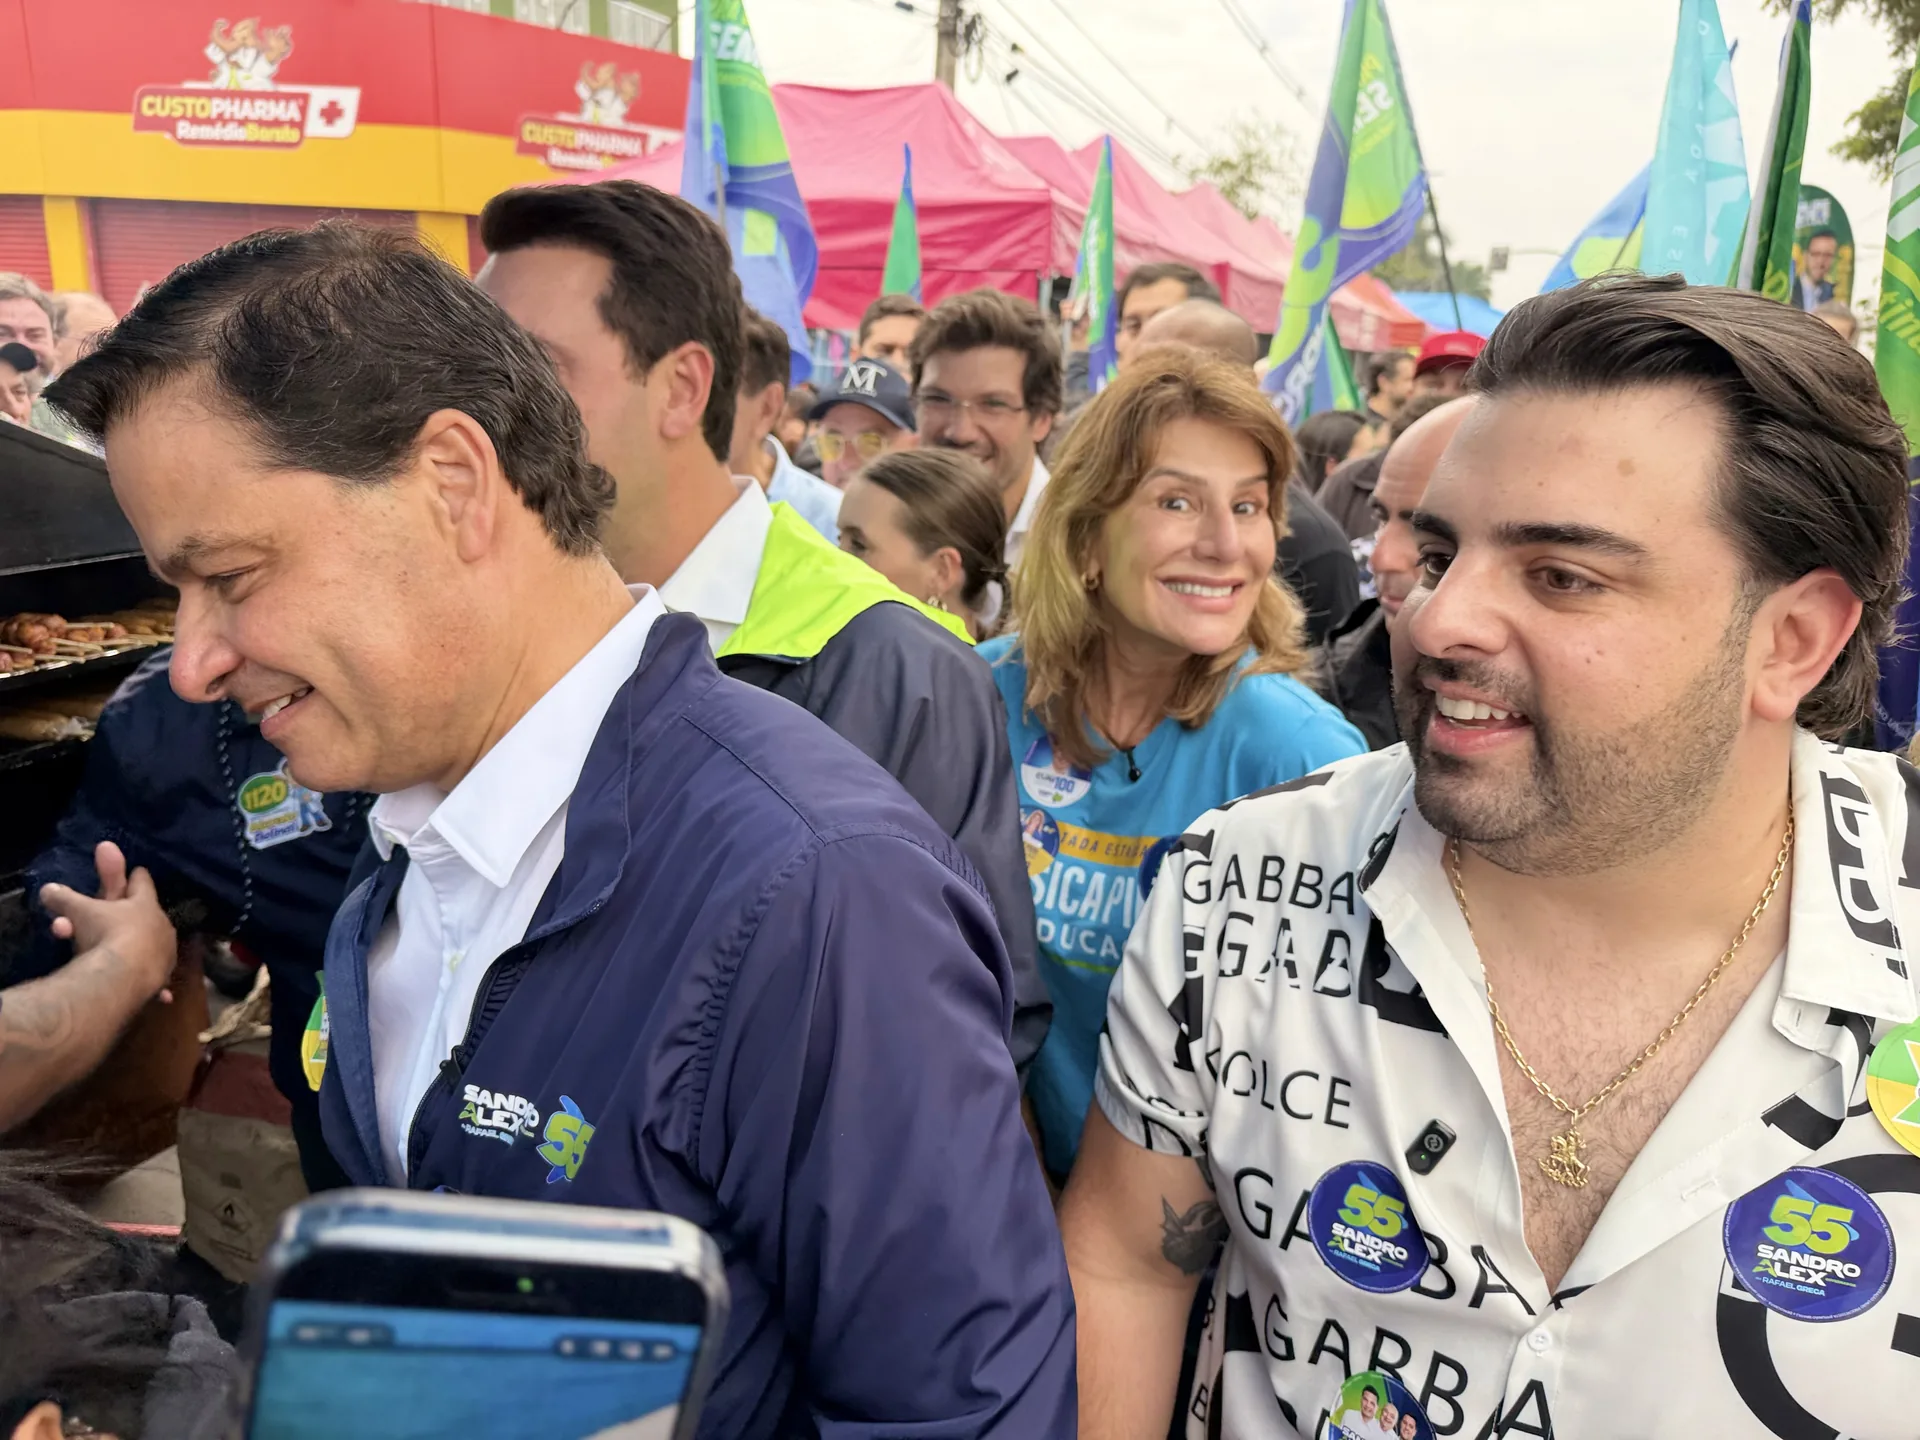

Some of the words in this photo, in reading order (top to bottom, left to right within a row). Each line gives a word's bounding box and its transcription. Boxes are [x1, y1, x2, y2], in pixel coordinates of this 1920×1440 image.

[141, 94, 301, 121] CUSTOPHARMA
[1182, 853, 1356, 915] GABBA
[538, 1110, 596, 1180] 55
[1337, 1182, 1406, 1239] 55
[1763, 1194, 1854, 1255] 55
[1326, 1235, 1383, 1265] ALEX
[1331, 1222, 1408, 1261] SANDRO
[1752, 1258, 1827, 1287] ALEX
[1756, 1244, 1861, 1279] SANDRO
[1762, 1276, 1796, 1290] RAFAEL
